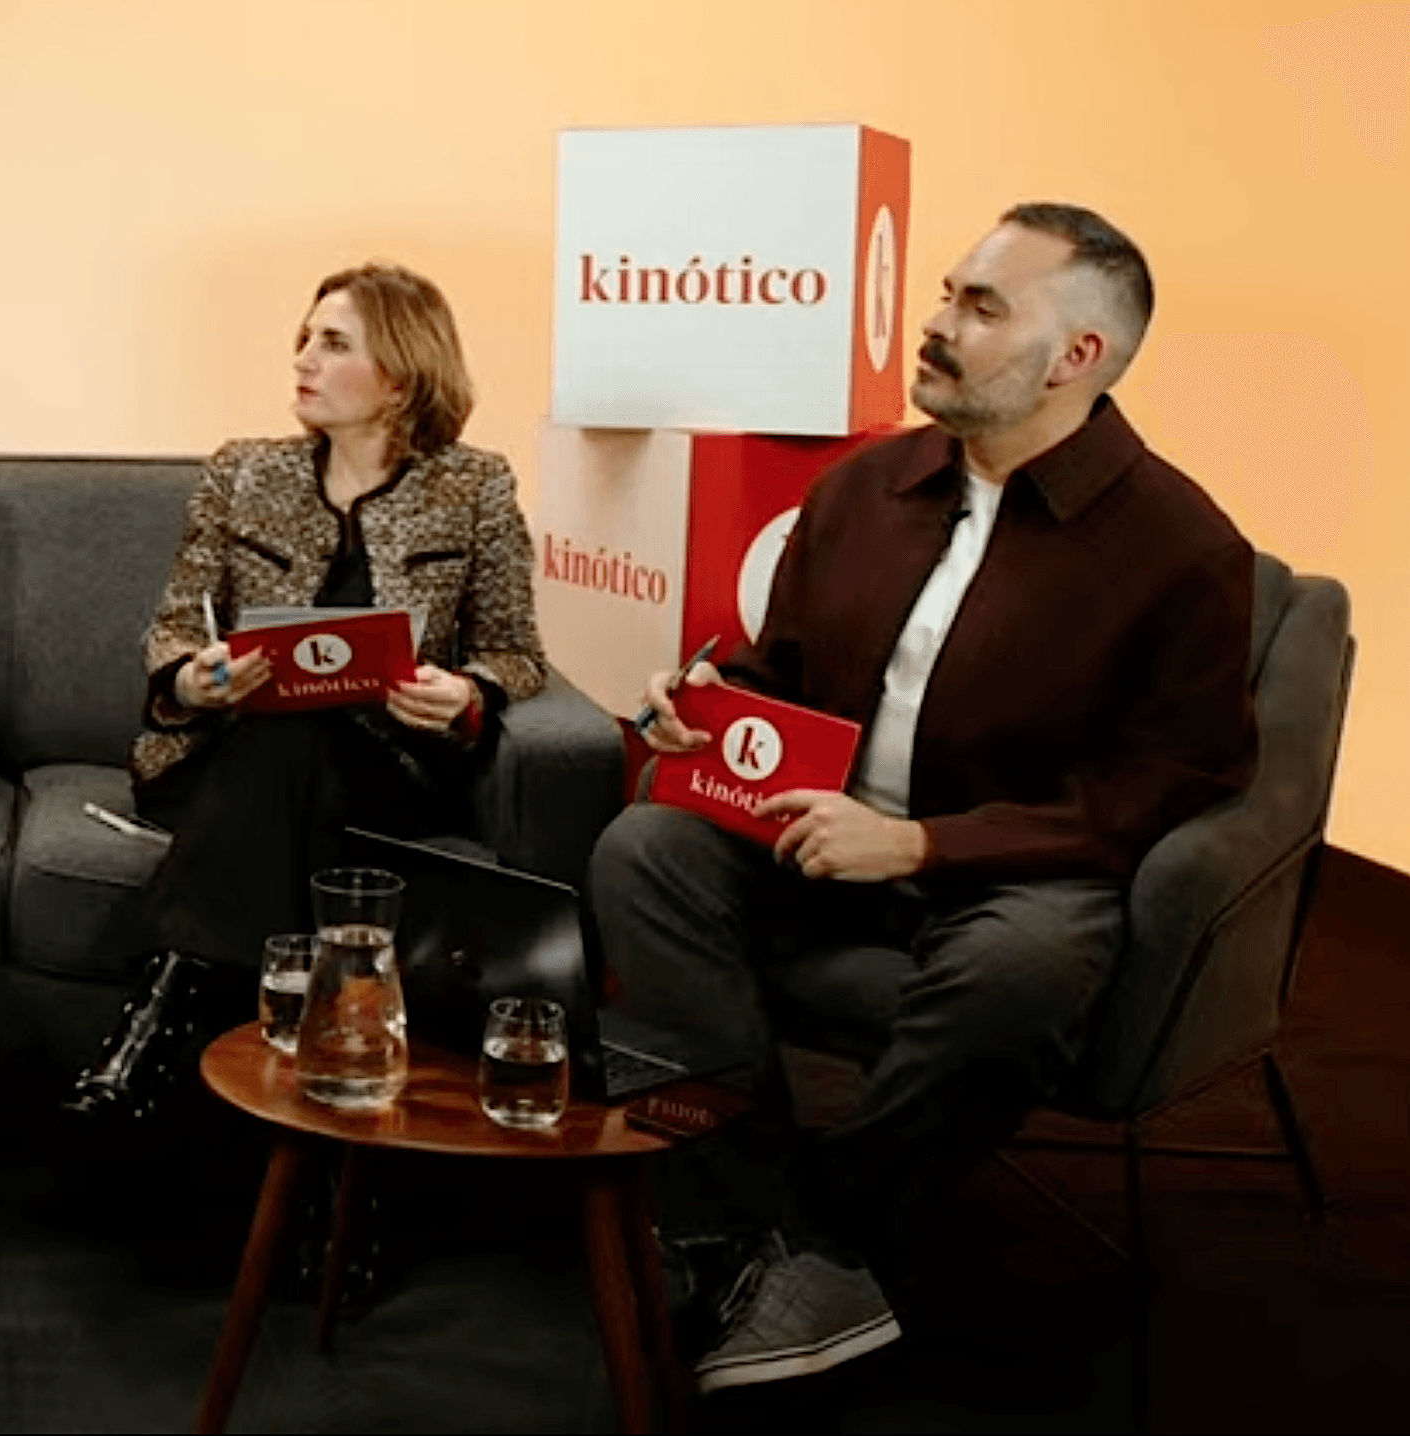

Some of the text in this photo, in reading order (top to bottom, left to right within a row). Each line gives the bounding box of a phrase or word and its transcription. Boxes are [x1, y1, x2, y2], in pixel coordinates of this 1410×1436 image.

[579, 253, 828, 305] kinótico
[543, 533, 668, 606] kinótico
[309, 641, 336, 666] k
[736, 725, 765, 770] k
